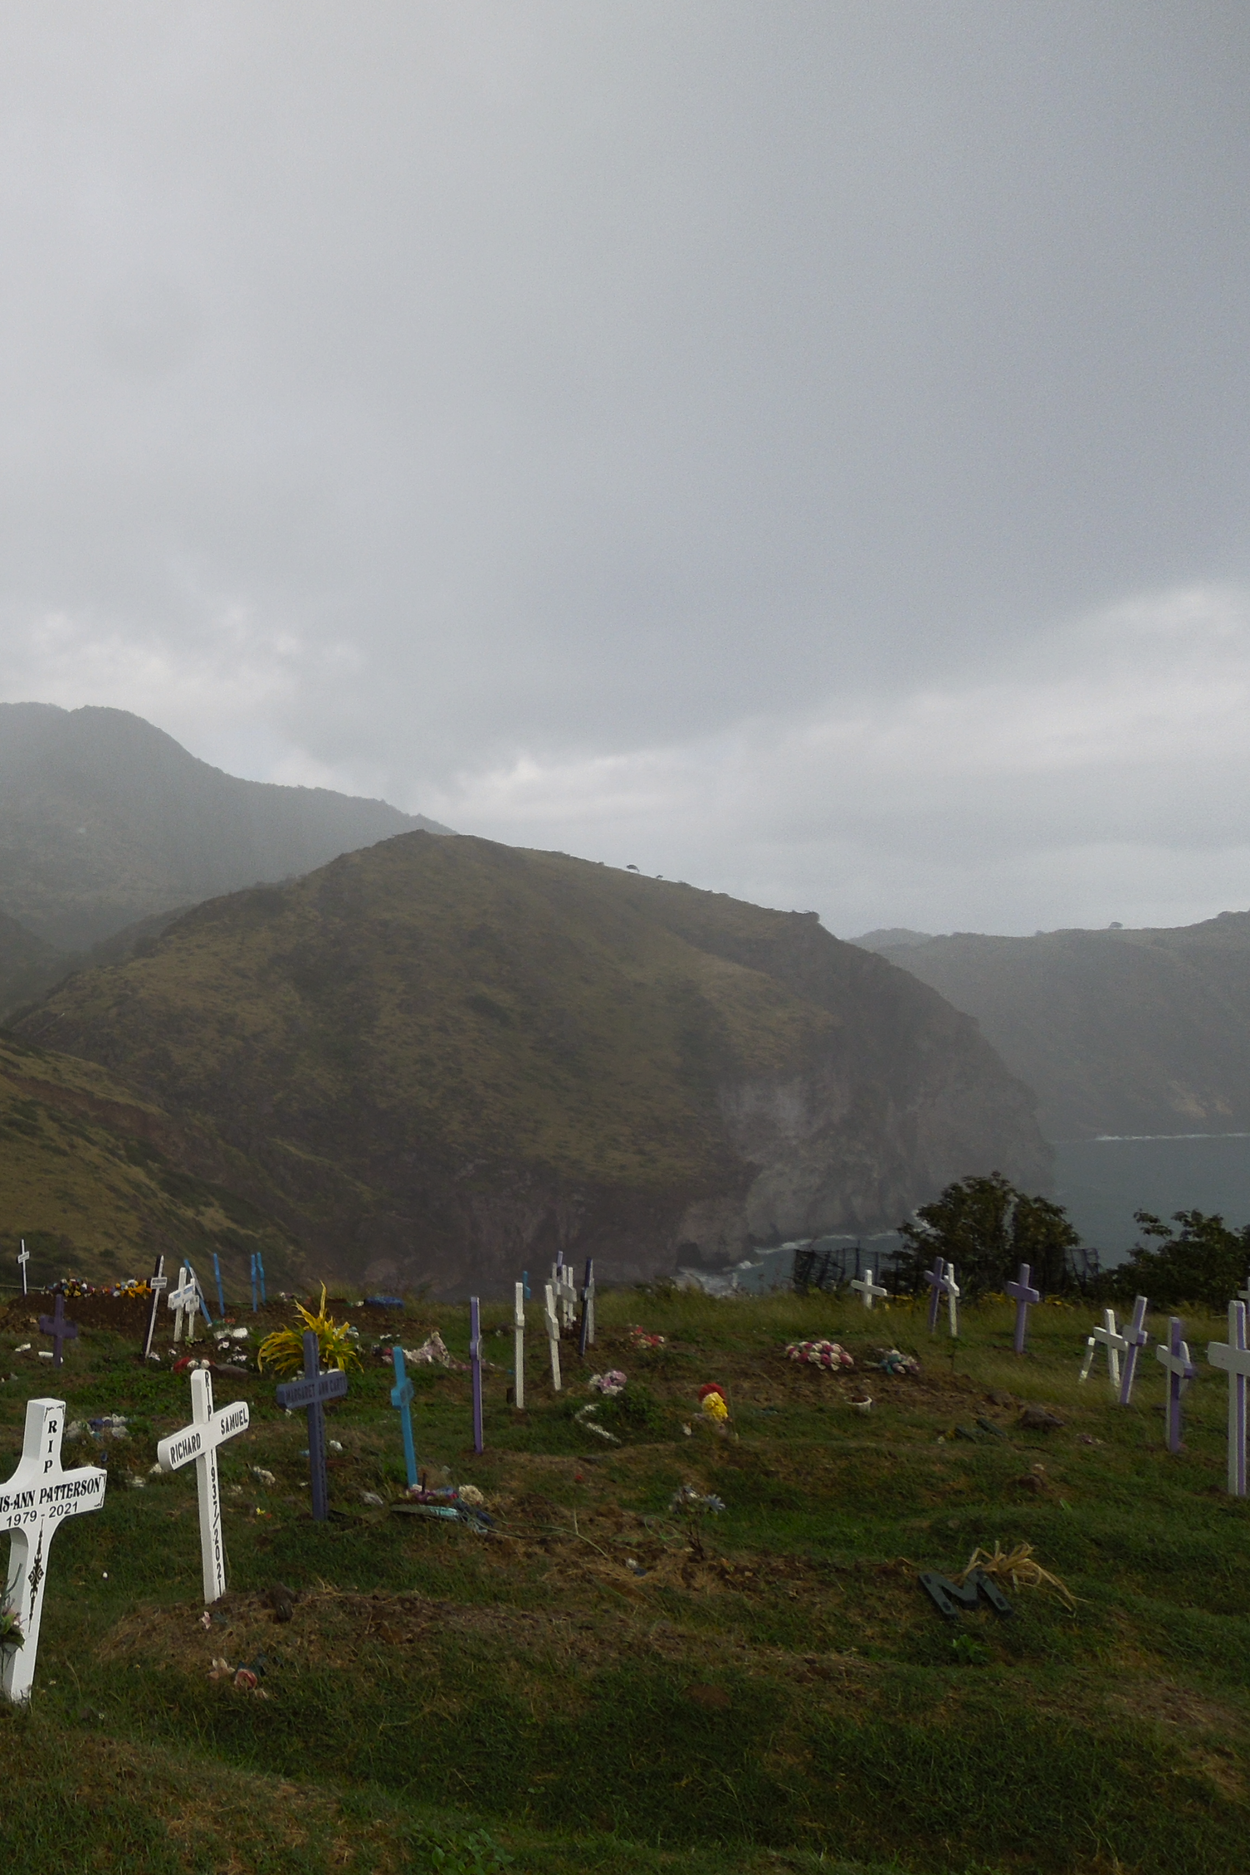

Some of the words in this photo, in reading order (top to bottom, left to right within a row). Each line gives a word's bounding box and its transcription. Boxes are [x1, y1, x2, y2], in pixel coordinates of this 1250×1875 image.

[43, 1420, 58, 1474] RIP
[170, 1433, 202, 1464] RICHARD
[220, 1408, 248, 1435] SAMUEL
[39, 1477, 102, 1504] PATTERSON
[6, 1510, 37, 1528] 1979
[49, 1501, 79, 1519] 2021
